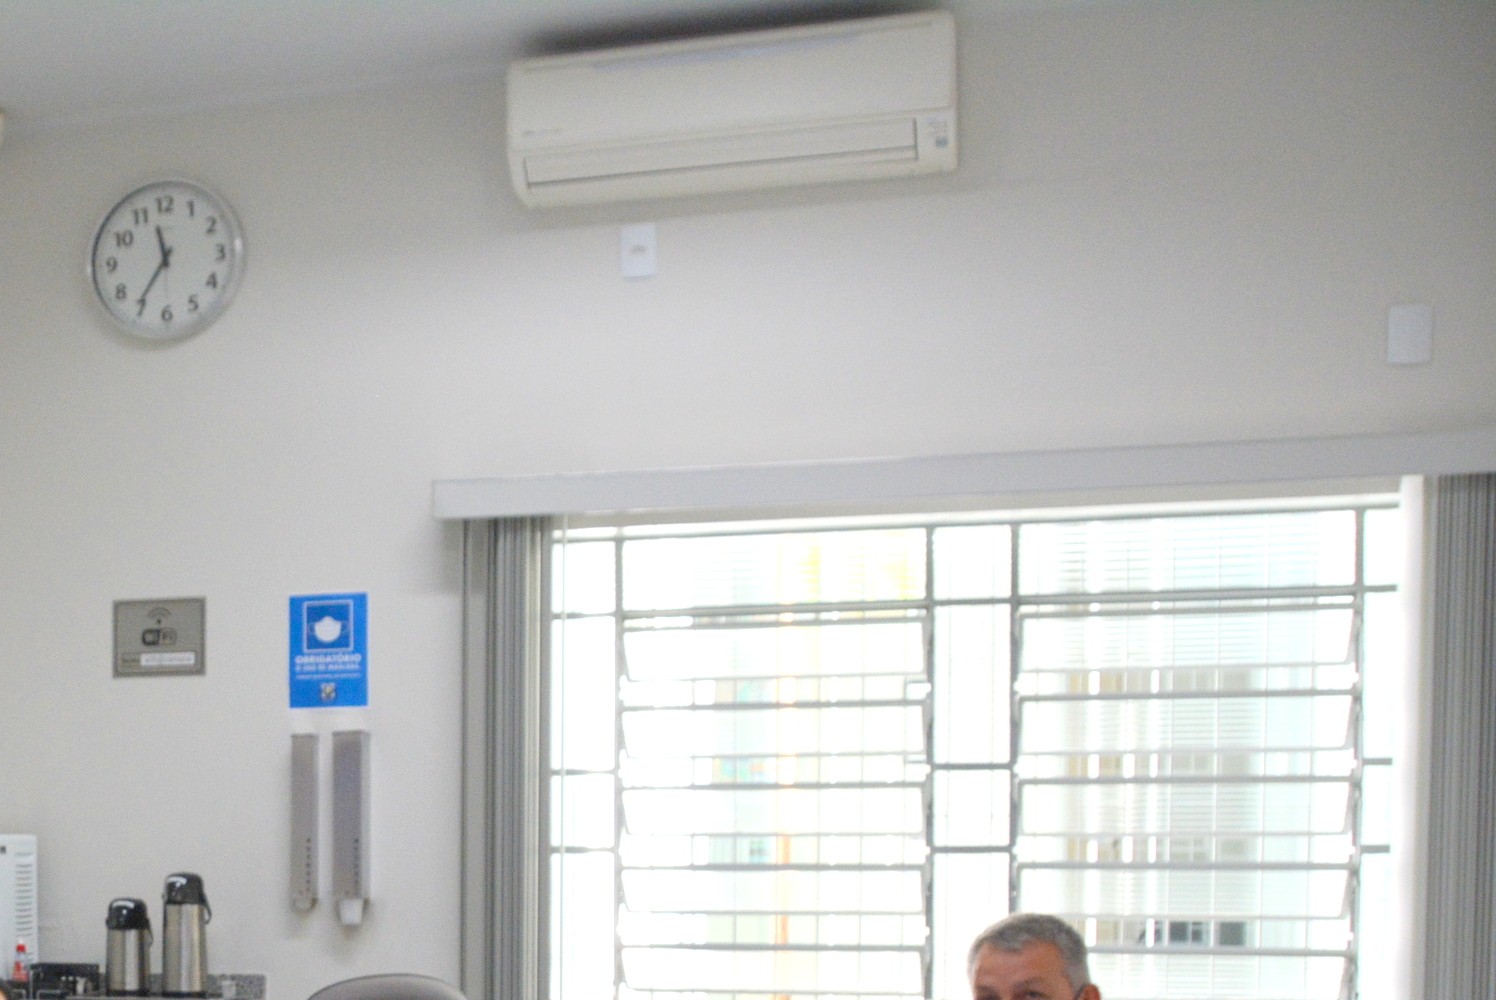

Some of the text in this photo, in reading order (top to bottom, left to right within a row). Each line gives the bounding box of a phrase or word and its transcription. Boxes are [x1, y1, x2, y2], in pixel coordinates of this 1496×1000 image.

[155, 196, 173, 213] 12
[187, 200, 195, 217] 1
[133, 207, 149, 225] 11
[206, 216, 217, 234] 2
[115, 230, 134, 247] 10
[216, 244, 226, 261] 3
[106, 256, 118, 272] 9
[207, 272, 218, 289] 4
[116, 282, 127, 300] 8
[188, 294, 199, 311] 5
[161, 305, 173, 321] 6
